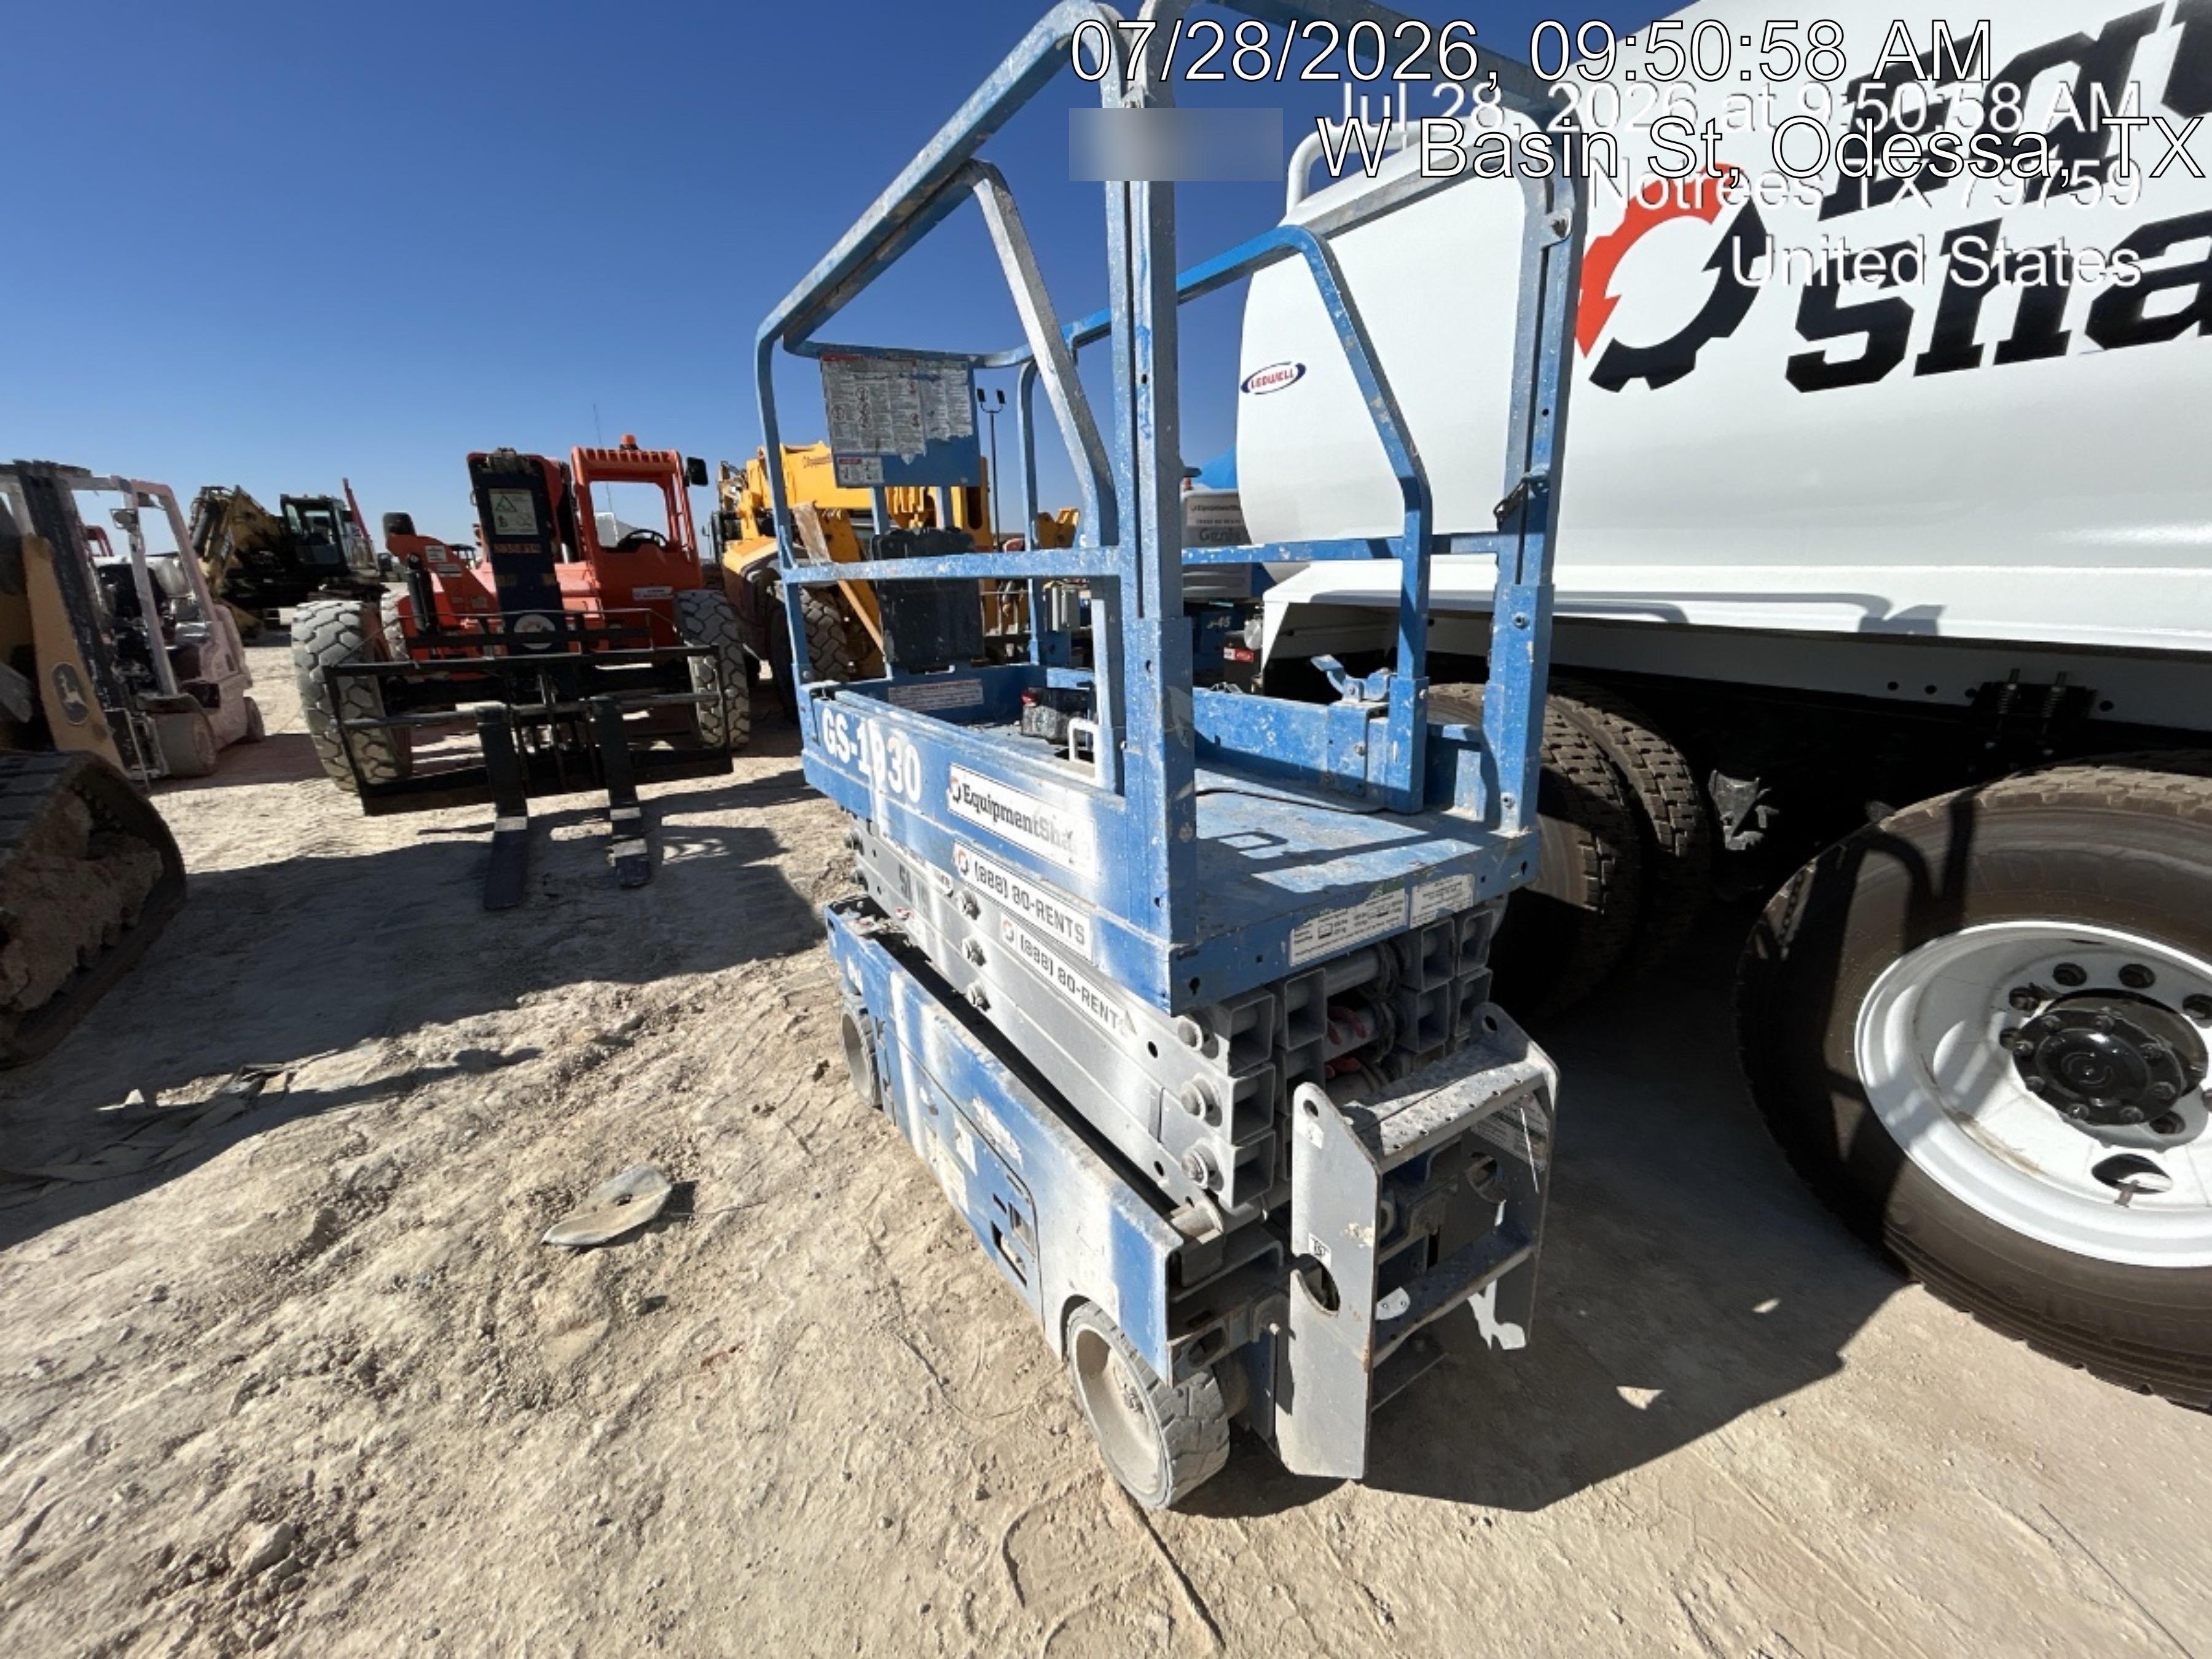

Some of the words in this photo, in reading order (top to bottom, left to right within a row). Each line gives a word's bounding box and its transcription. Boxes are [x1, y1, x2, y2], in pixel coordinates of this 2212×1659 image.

[975, 861, 1009, 898] (888)
[1012, 884, 1085, 946] 80-RENTS
[1020, 933, 1054, 976] (888)
